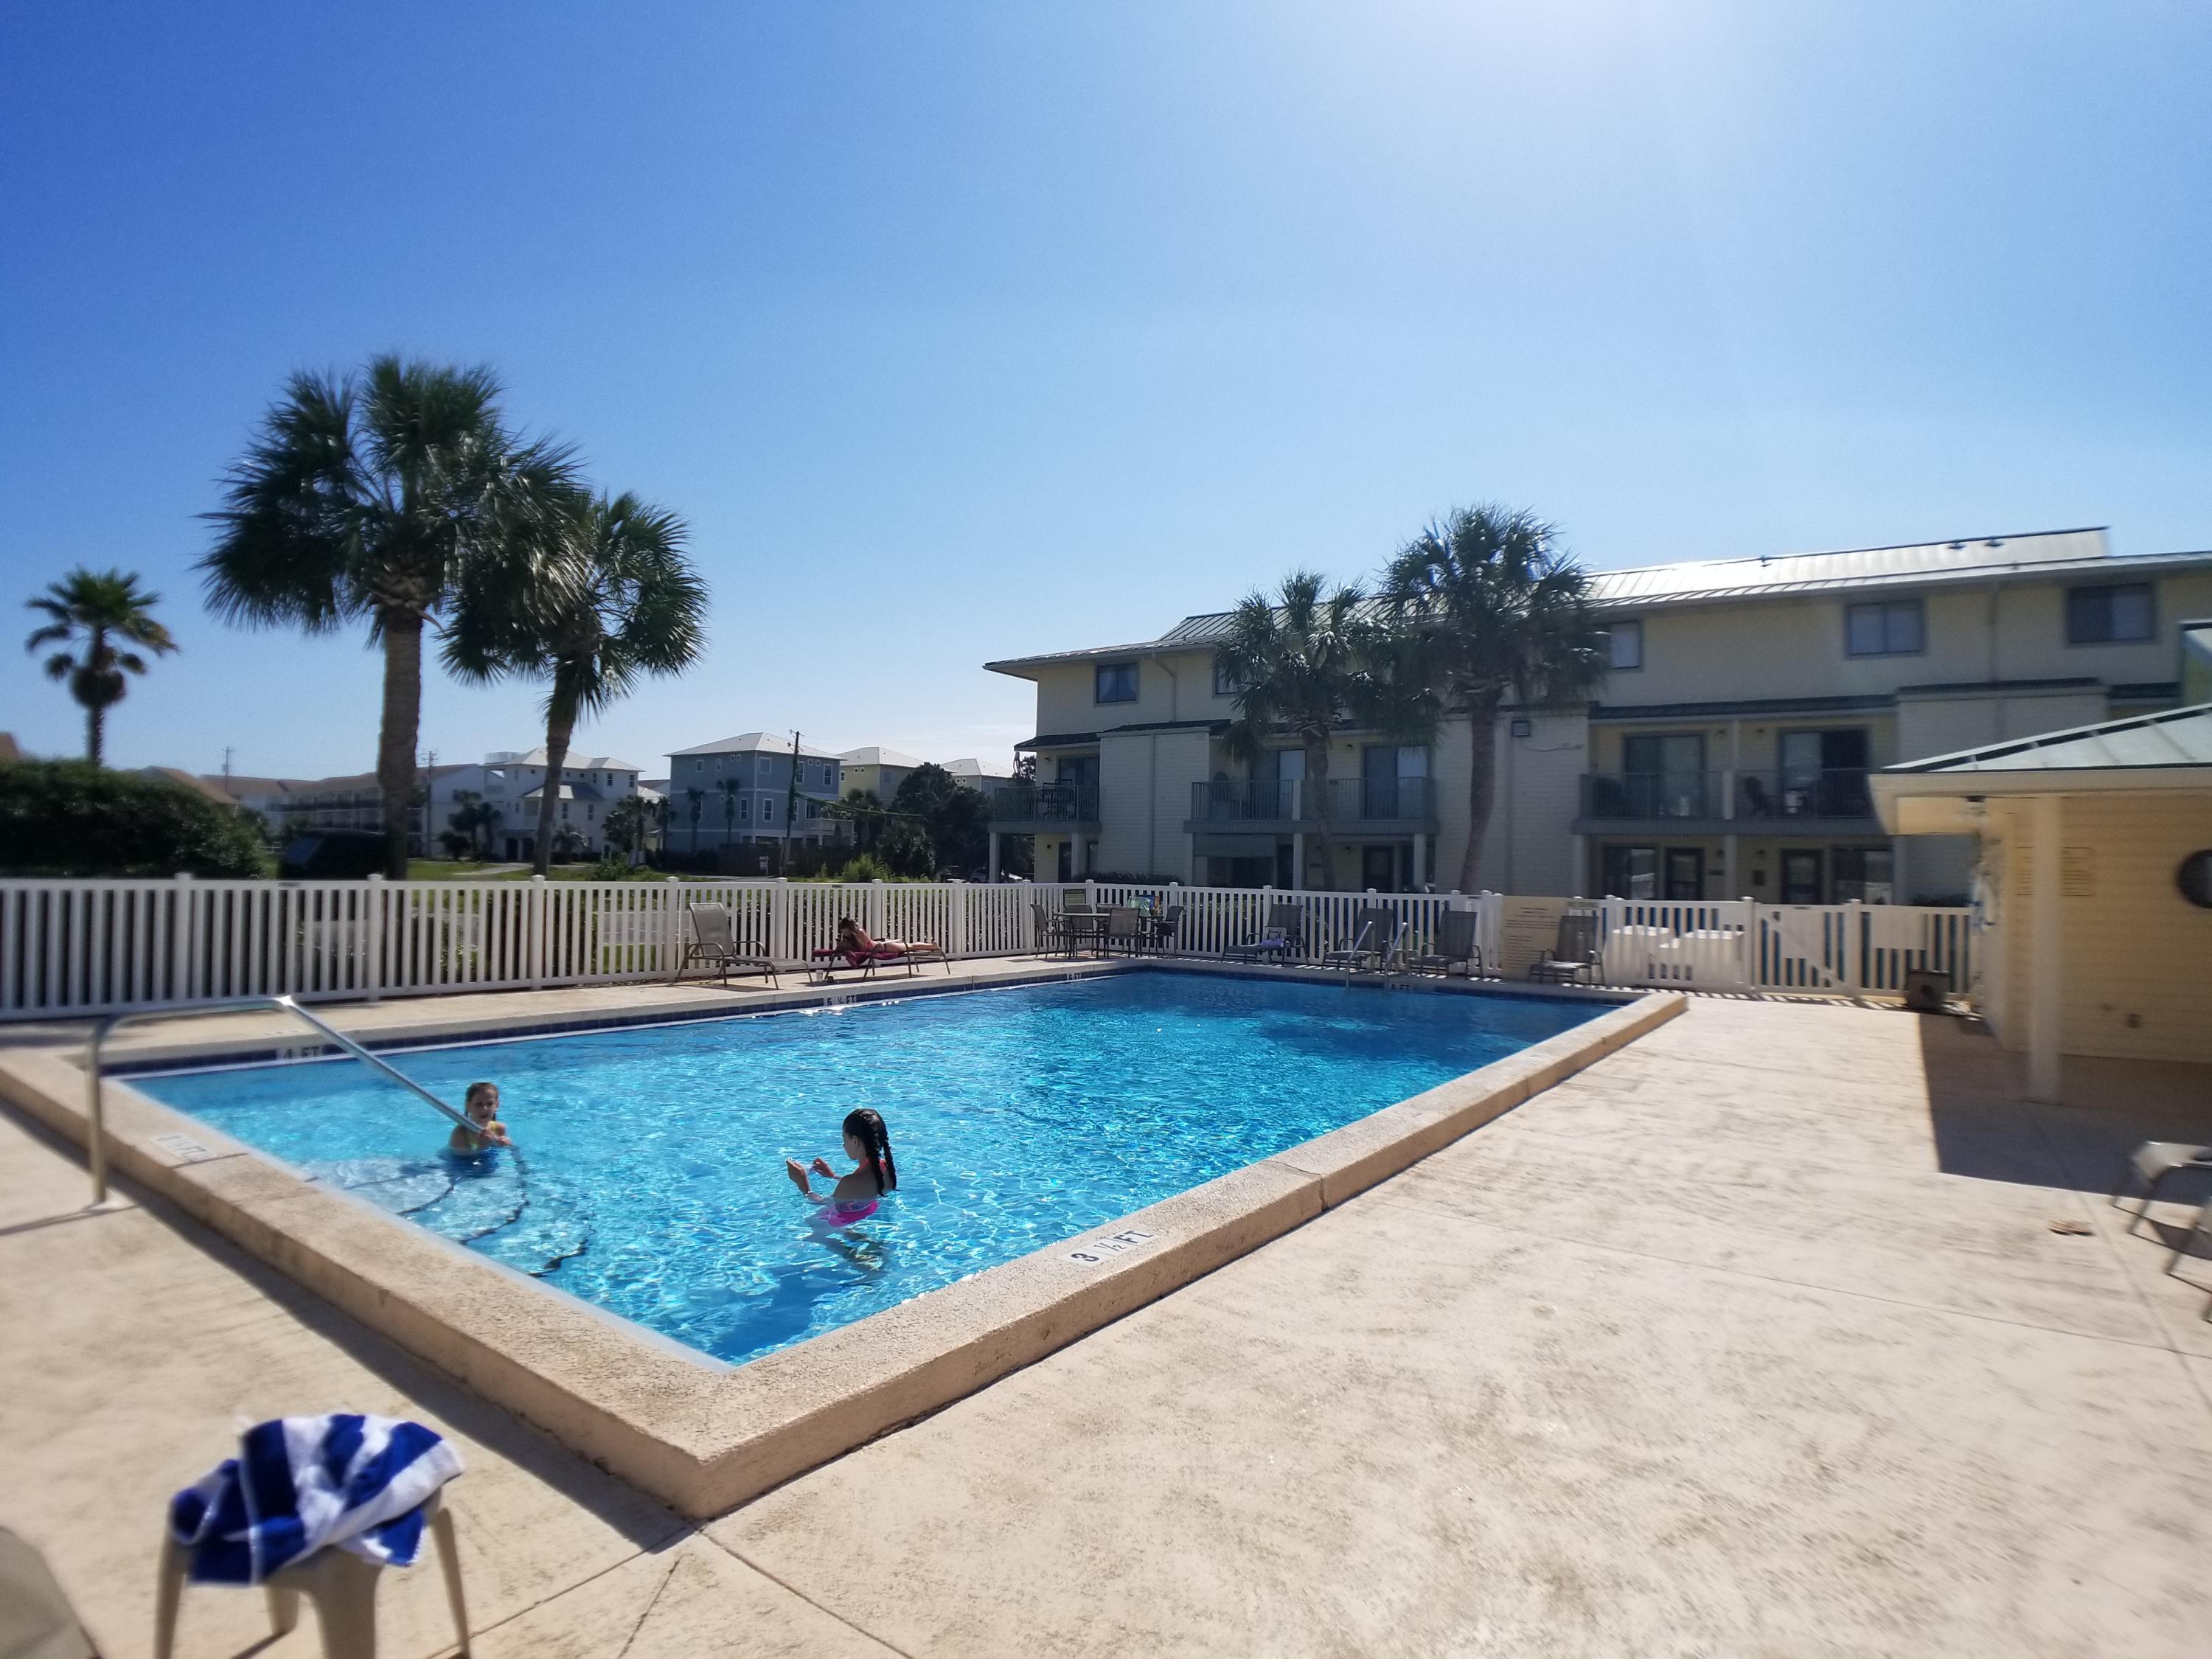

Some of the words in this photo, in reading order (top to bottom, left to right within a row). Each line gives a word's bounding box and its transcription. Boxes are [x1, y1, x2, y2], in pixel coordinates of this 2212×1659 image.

[827, 998, 832, 1006] 5
[846, 995, 855, 1004] FT
[283, 1048, 293, 1060] 4
[300, 1046, 319, 1058] FT
[1071, 1252, 1100, 1262] 3
[1114, 1230, 1155, 1245] FT
